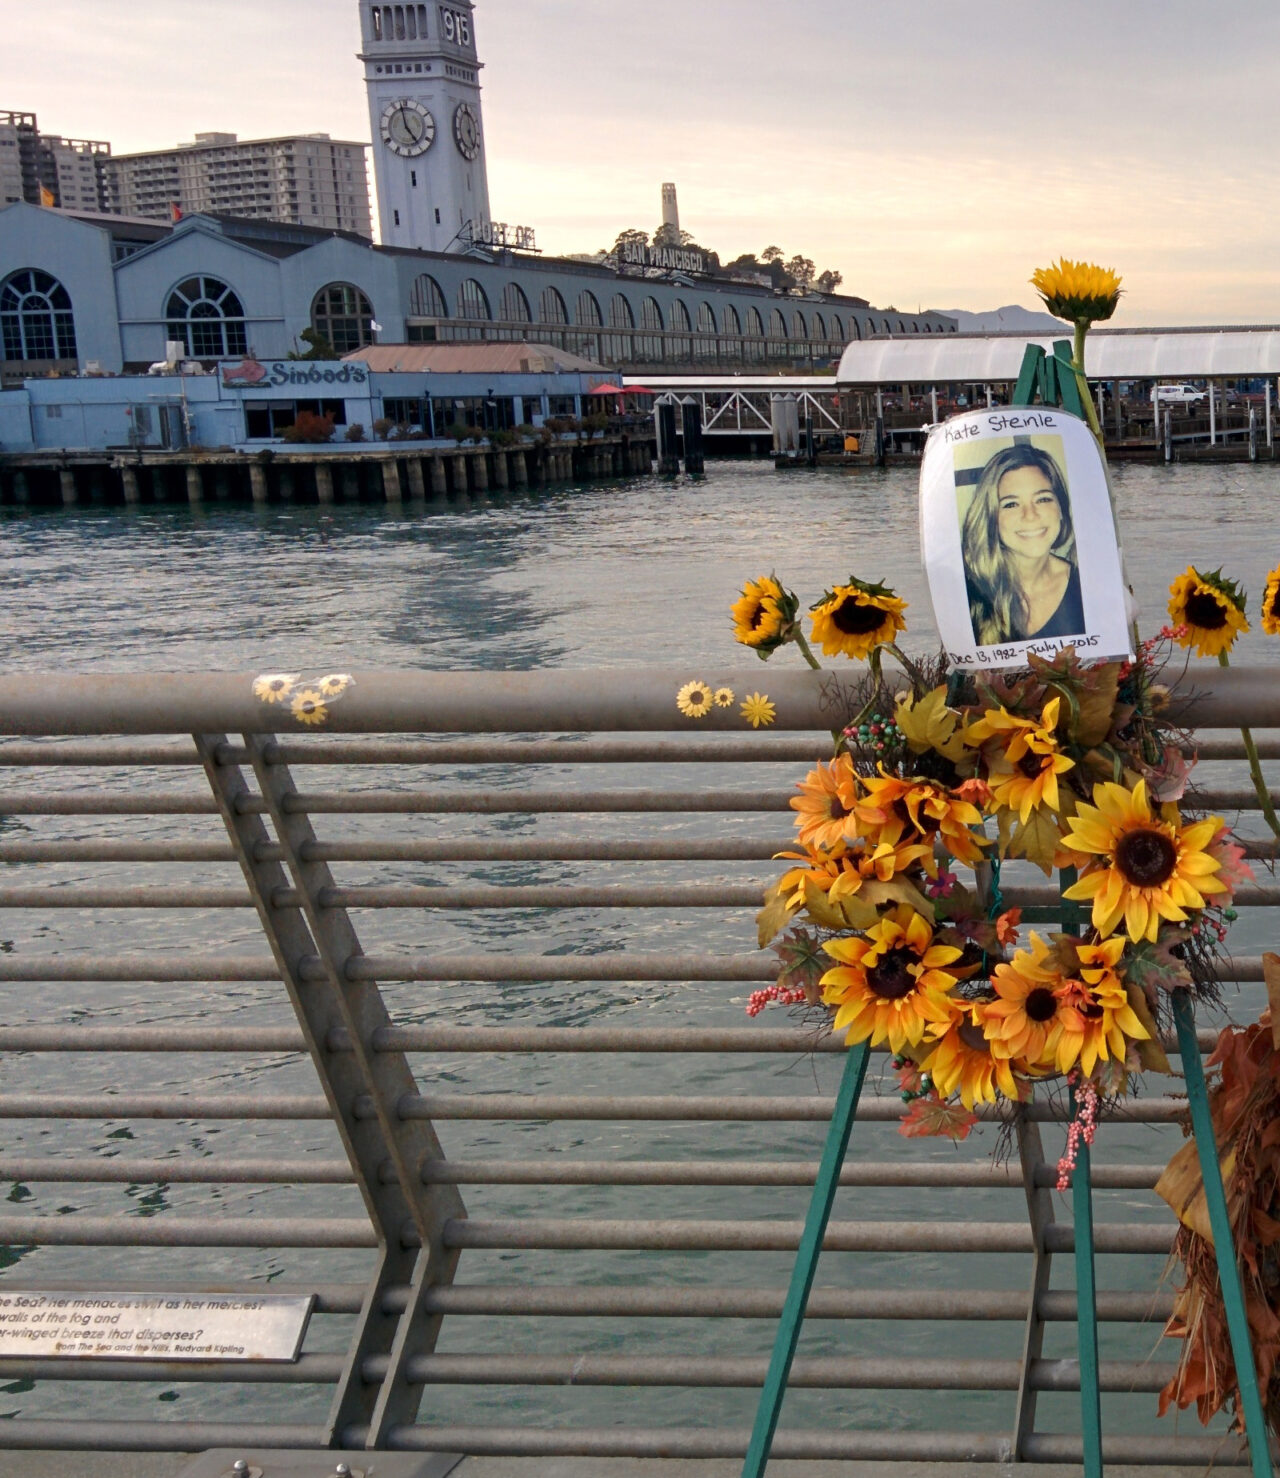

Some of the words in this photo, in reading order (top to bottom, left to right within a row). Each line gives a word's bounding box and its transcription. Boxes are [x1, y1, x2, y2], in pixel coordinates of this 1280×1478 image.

[624, 242, 645, 264] SAN
[649, 246, 703, 272] FRANCISCO
[270, 362, 367, 386] Sinbad's
[944, 424, 980, 443] Kate
[988, 413, 1058, 431] Steinle
[949, 652, 974, 665] Dec
[993, 649, 1018, 661] 1982
[1026, 640, 1058, 659] July
[1070, 635, 1100, 649] 2015
[13, 1296, 47, 1308] Sea?
[72, 1299, 131, 1309] menaces
[165, 1301, 180, 1309] as
[182, 1299, 205, 1310] her
[31, 1311, 46, 1323] of
[46, 1311, 67, 1323] the
[69, 1312, 92, 1326] fog
[94, 1312, 121, 1324] and
[60, 1327, 105, 1339] breeze
[107, 1328, 135, 1340] that
[135, 1328, 204, 1342] disperses?
[77, 1342, 94, 1351] The
[95, 1342, 113, 1352] Sea
[114, 1343, 133, 1352] and
[174, 1344, 213, 1355] Rudyard
[213, 1345, 245, 1355] Kipling
